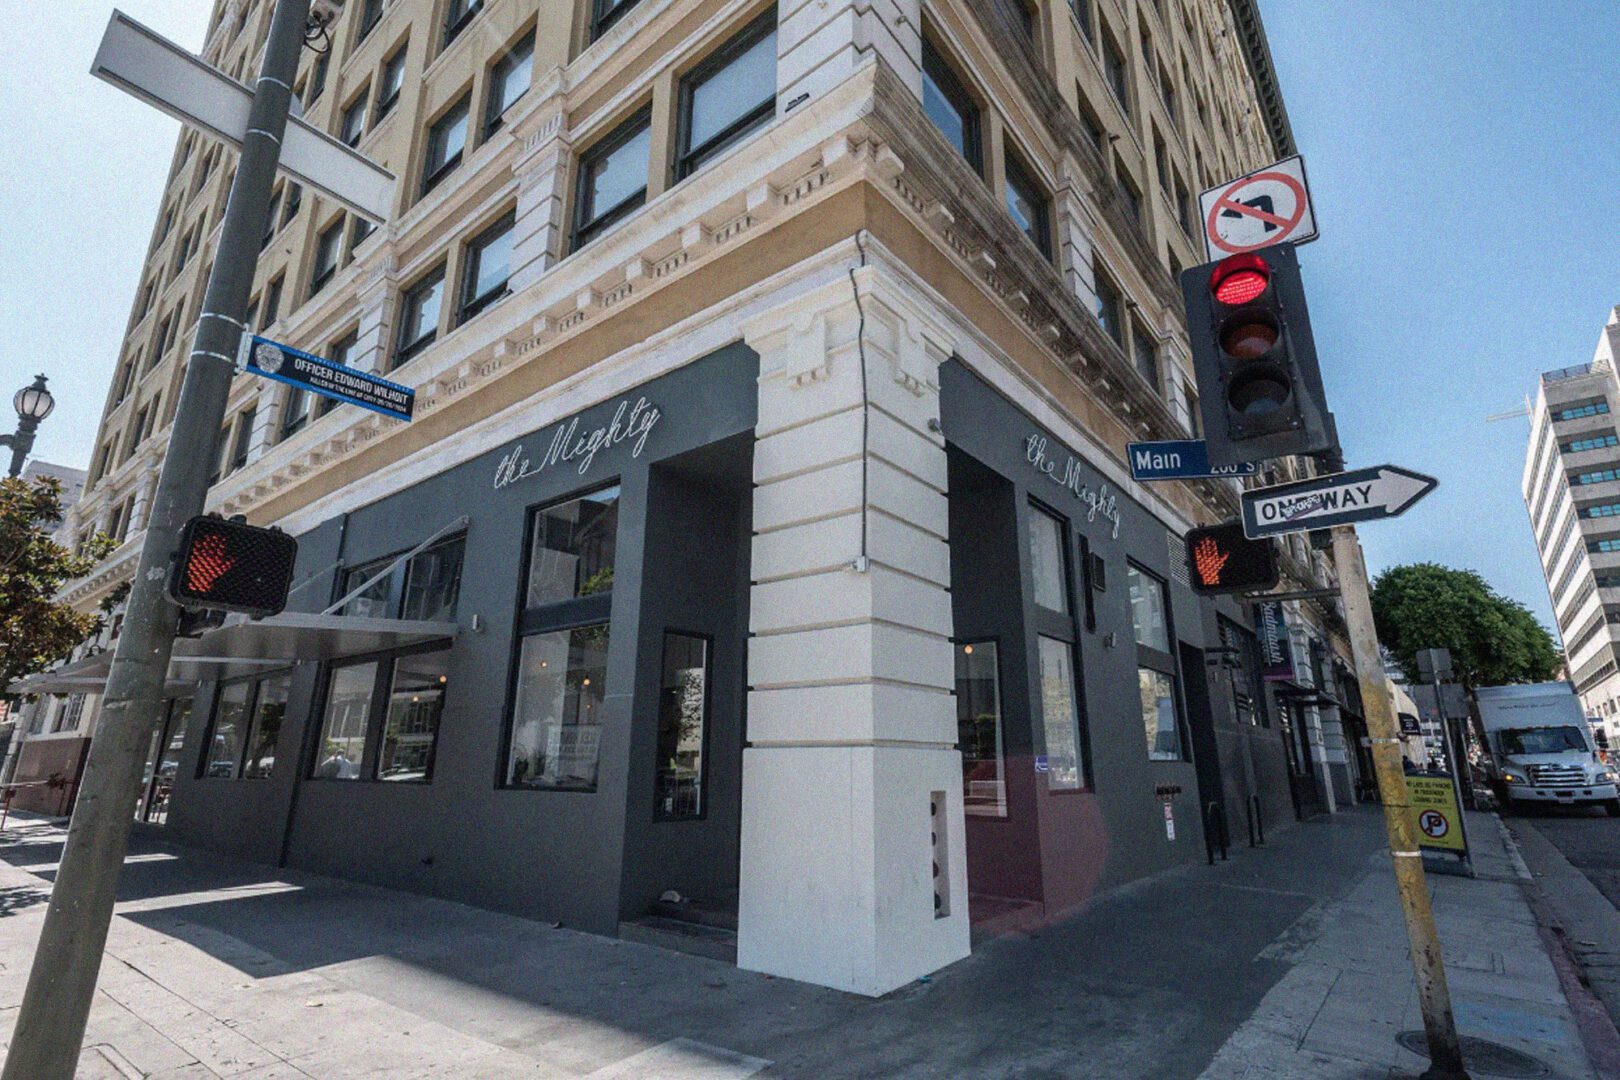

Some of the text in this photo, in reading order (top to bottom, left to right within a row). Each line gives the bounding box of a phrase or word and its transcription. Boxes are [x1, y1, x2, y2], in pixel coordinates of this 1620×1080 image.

[294, 359, 334, 380] OFFICER
[334, 371, 373, 394] EDWARD
[493, 396, 661, 489] the Mighty
[1135, 450, 1181, 471] Main
[1026, 433, 1120, 539] the Mighty
[1319, 484, 1372, 511] WAY
